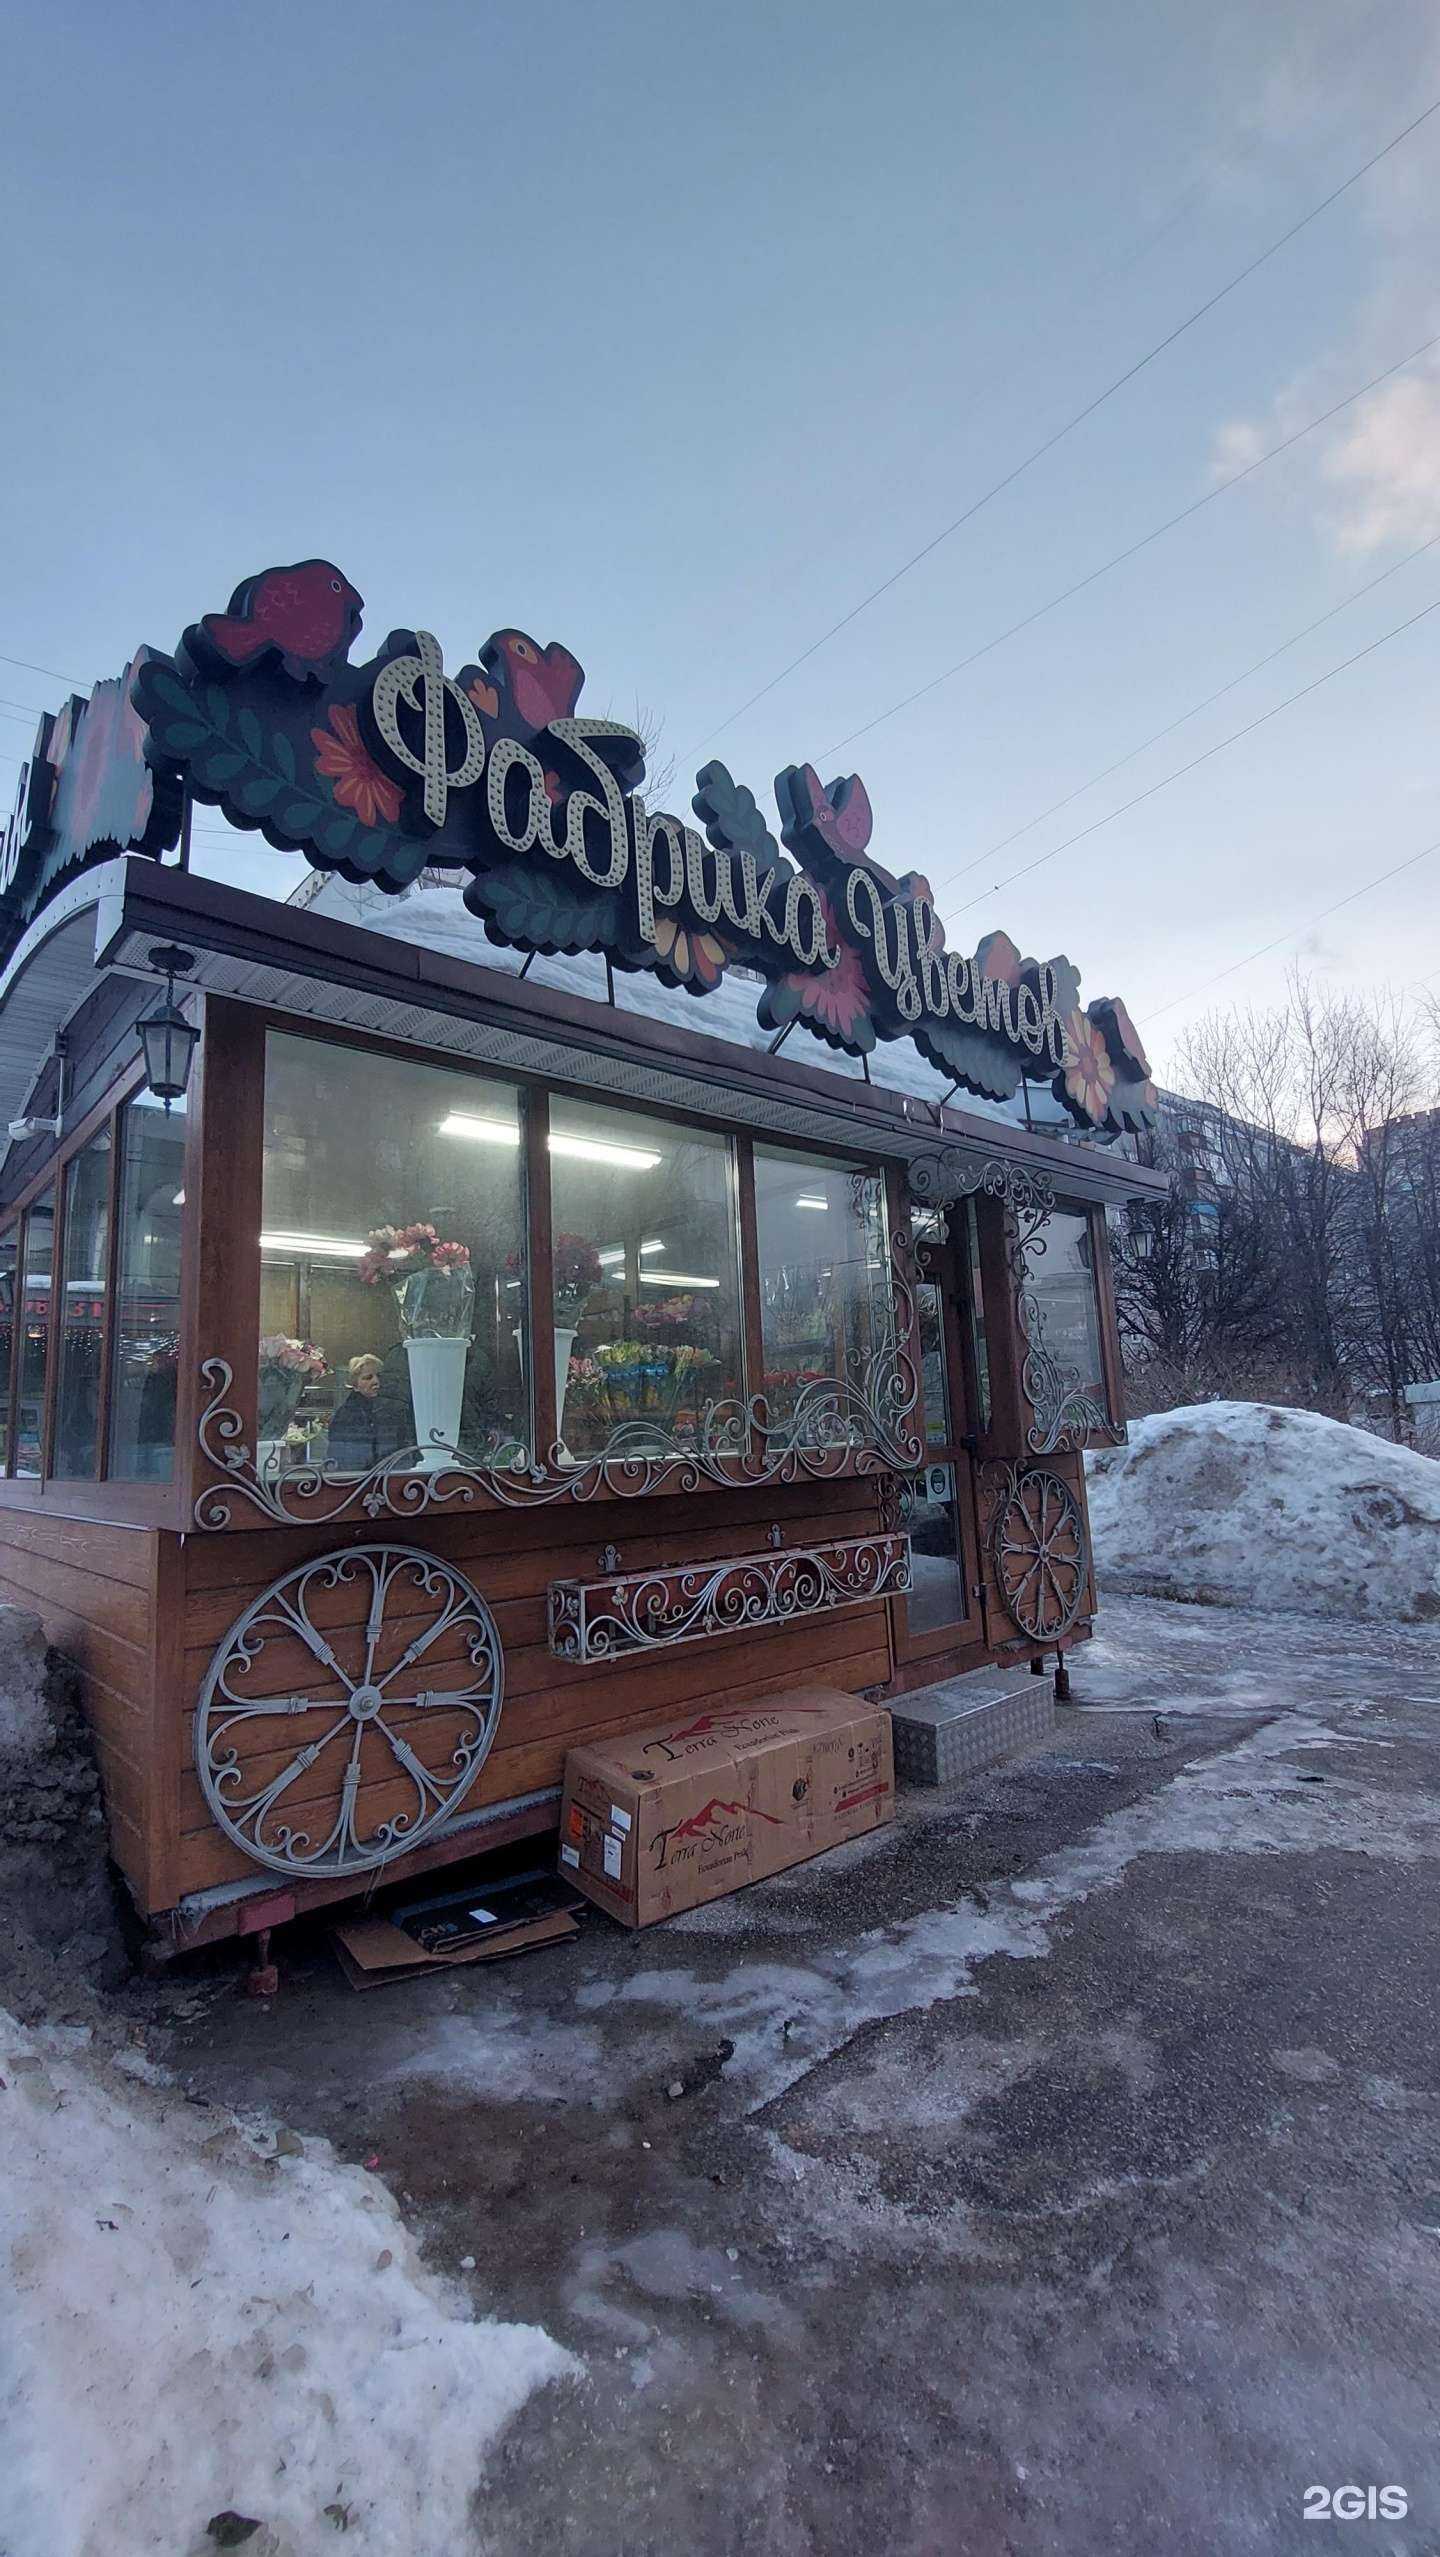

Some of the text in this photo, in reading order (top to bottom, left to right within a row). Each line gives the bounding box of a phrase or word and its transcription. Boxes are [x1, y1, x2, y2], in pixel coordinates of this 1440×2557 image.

[373, 630, 1070, 1067] Фабрика Цветов
[642, 1734, 718, 1762] Terra
[649, 1818, 699, 1871] Terra
